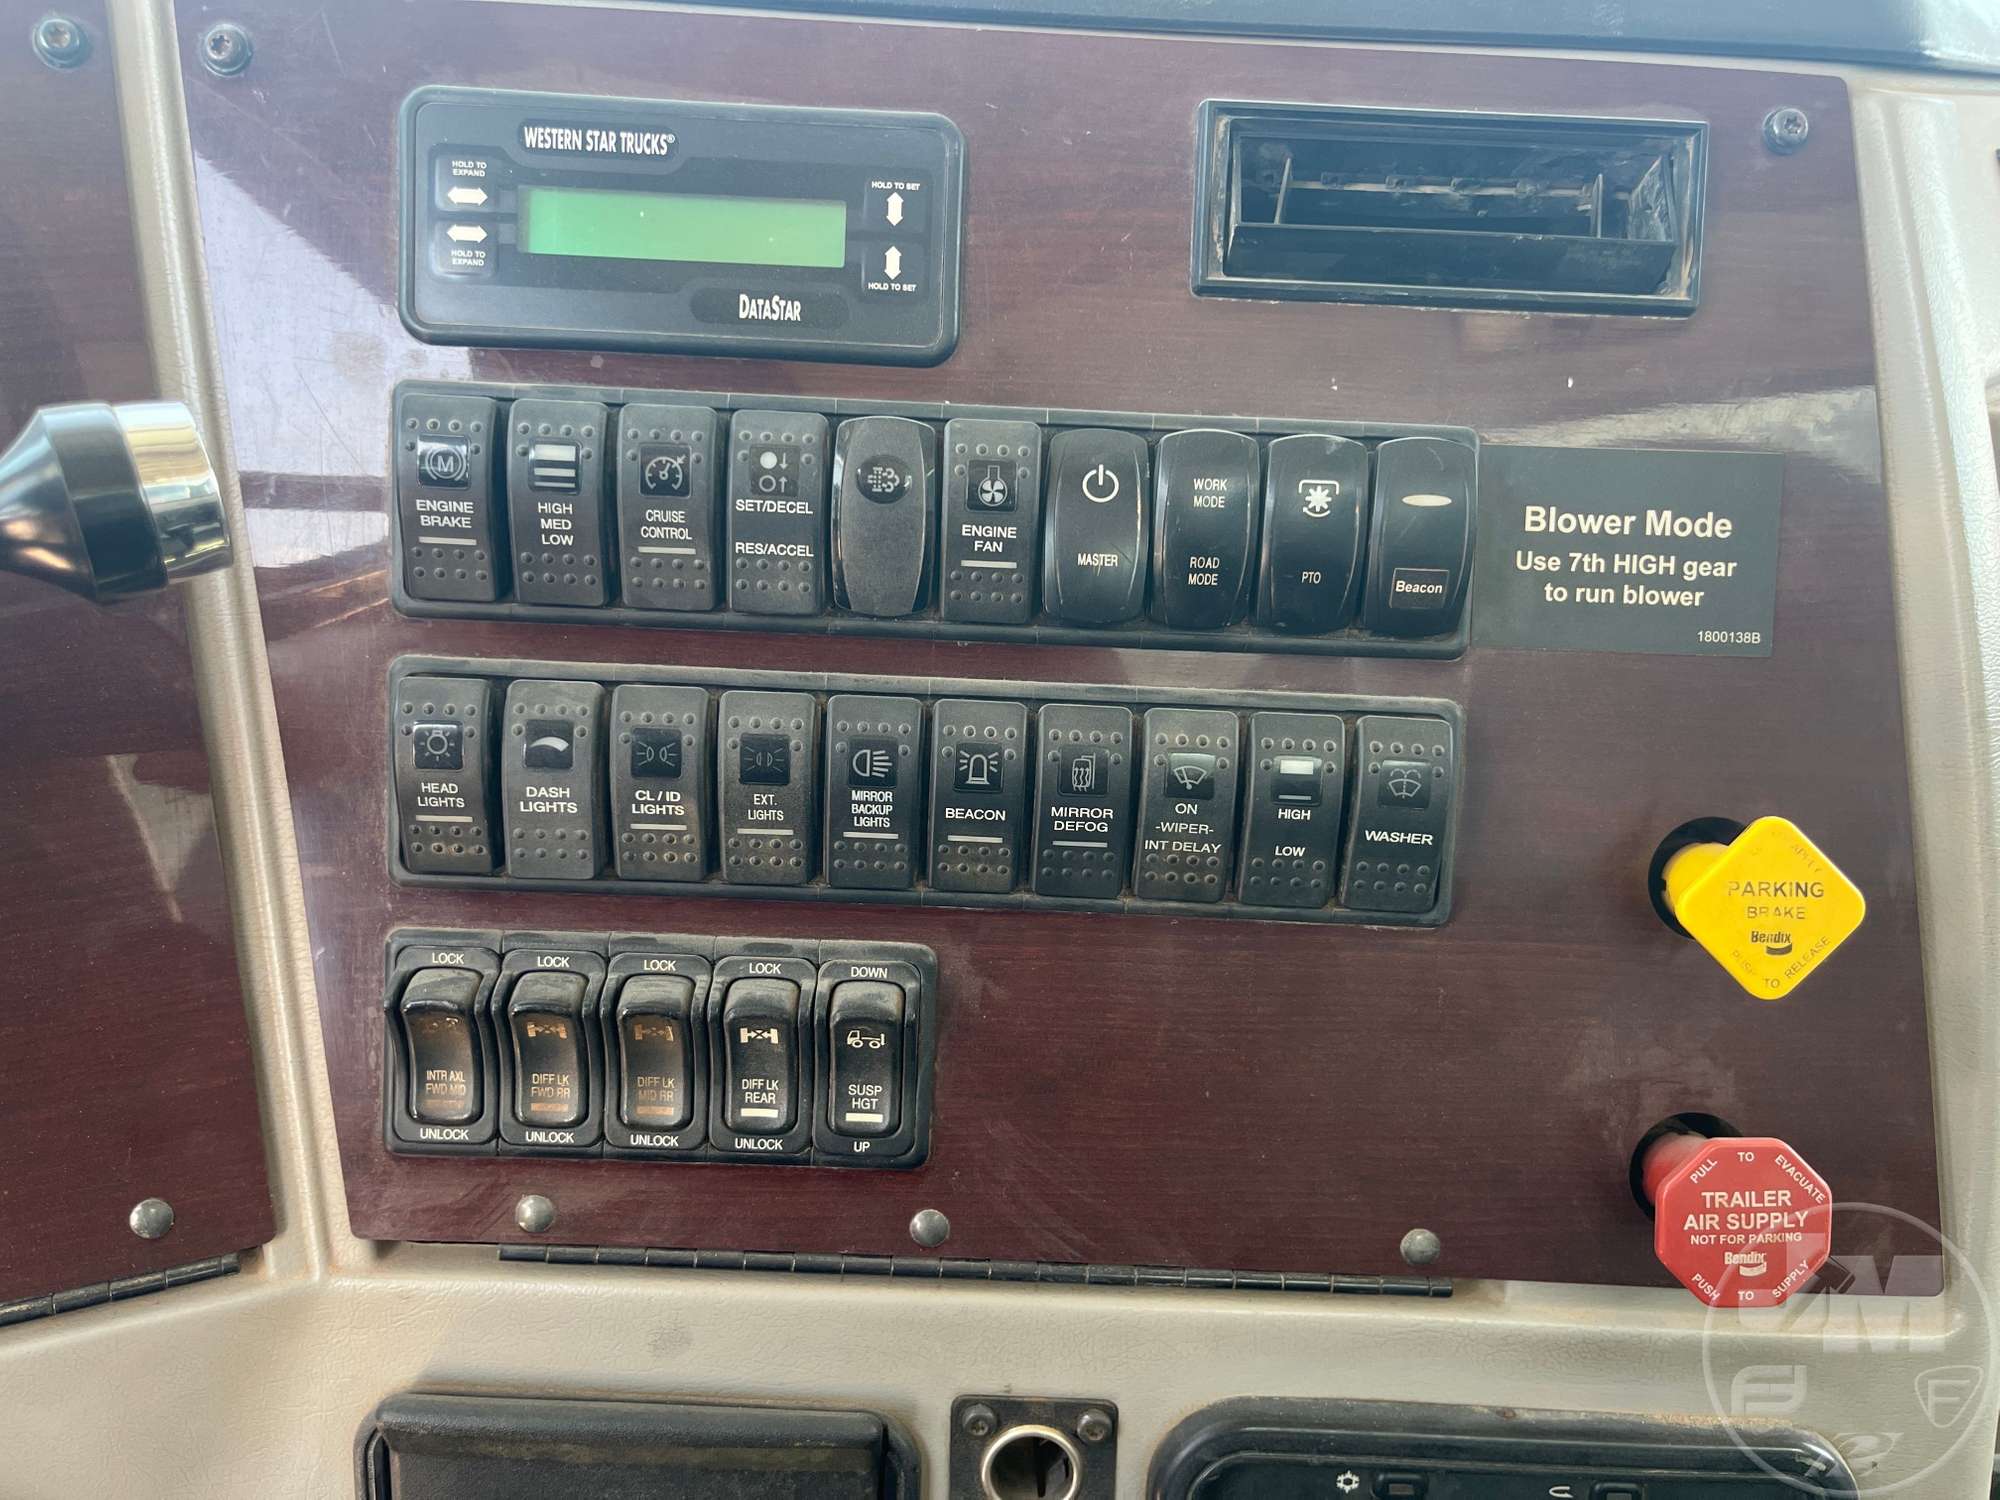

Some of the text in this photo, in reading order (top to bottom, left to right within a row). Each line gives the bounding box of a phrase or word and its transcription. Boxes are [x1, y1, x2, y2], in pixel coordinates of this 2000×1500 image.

[524, 126, 582, 151] WESTERN
[586, 129, 617, 153] STAR
[452, 161, 487, 170] HOLD TO
[453, 168, 486, 178] EXPAND
[871, 181, 920, 191] HOLD TO SET
[451, 250, 486, 259] HOLD TO
[452, 258, 485, 267] EXPAND
[868, 282, 917, 292] HOLD TO SET
[1193, 478, 1227, 492] WORK
[416, 499, 474, 514] ENGINE
[735, 499, 813, 515] SET/DECEL
[1193, 495, 1225, 508] MODE
[538, 502, 573, 515] HIGH
[420, 515, 472, 528] BRAKE
[646, 509, 685, 523] CRUISE
[1524, 505, 1733, 539] Blower Mode
[540, 518, 572, 530] MED
[640, 526, 692, 541] CONTROL
[962, 524, 1017, 539] ENGINE
[542, 534, 574, 546] LOW
[974, 540, 1003, 553] FAN
[735, 542, 814, 557] RES/ACCEL
[1077, 552, 1118, 568] MASTER
[1189, 556, 1220, 570] ROAD
[1516, 550, 1737, 581] Use 7th HIGH gear
[1188, 572, 1218, 586] MODE
[1301, 571, 1321, 585] PTO
[1395, 580, 1443, 595] Beacon
[1544, 582, 1704, 606] to run blower
[1697, 631, 1761, 644] 1800138B
[421, 782, 459, 795] HEAD
[526, 786, 570, 798] DASH
[417, 796, 465, 808] LIGHTS
[753, 794, 778, 806] EXT.
[851, 790, 893, 802] MIRROR
[520, 801, 578, 814] LIGHTS
[631, 803, 685, 816] LIGHTS
[851, 804, 893, 816] BACKUP
[945, 807, 1006, 821] BEACON
[1051, 806, 1114, 820] MIRROR
[1175, 803, 1198, 815] ON
[748, 809, 784, 822] LIGHTS
[1278, 808, 1311, 821] HIGH
[853, 816, 890, 828] LIGHTS
[1053, 820, 1109, 833] DEFOG
[1365, 830, 1433, 846] WASHER
[1144, 839, 1221, 854] INT DELAY
[1275, 845, 1305, 857] LOW
[1728, 881, 1825, 898] PARKING
[1747, 906, 1806, 920] BRAKE
[1751, 930, 1791, 944] Bendix
[432, 952, 464, 965] LOCK
[537, 956, 570, 968] LOCK
[643, 959, 676, 971] LOCK
[1762, 977, 1780, 989] TO
[1784, 935, 1832, 978] RELEASE
[749, 963, 781, 975] LOCK
[851, 967, 888, 979] DOWN
[426, 1070, 466, 1083] INTR AXL
[532, 1073, 570, 1086] DIFF LK
[637, 1076, 675, 1089] DIFF LK
[425, 1083, 447, 1095] FWD
[742, 1079, 779, 1091] DIFF LK
[848, 1084, 882, 1097] SUSP
[531, 1086, 554, 1098] FWD
[745, 1092, 776, 1104] REAR
[851, 1098, 878, 1110] HGT
[420, 1127, 469, 1141] UNLOCK
[525, 1131, 574, 1144] UNLOCK
[630, 1134, 678, 1147] UNLOCK
[735, 1138, 783, 1151] UNLOCK
[853, 1141, 870, 1153] UP
[1689, 1151, 1826, 1204] PULL TO EVACUATE
[1701, 1189, 1792, 1208] TRAILER
[1683, 1211, 1808, 1230] AIR SUPPLY
[1690, 1232, 1802, 1245] NOT FOR PARKING
[1724, 1251, 1767, 1265] Bendix
[1691, 1259, 1809, 1300] PUSH TO SUPPLY
